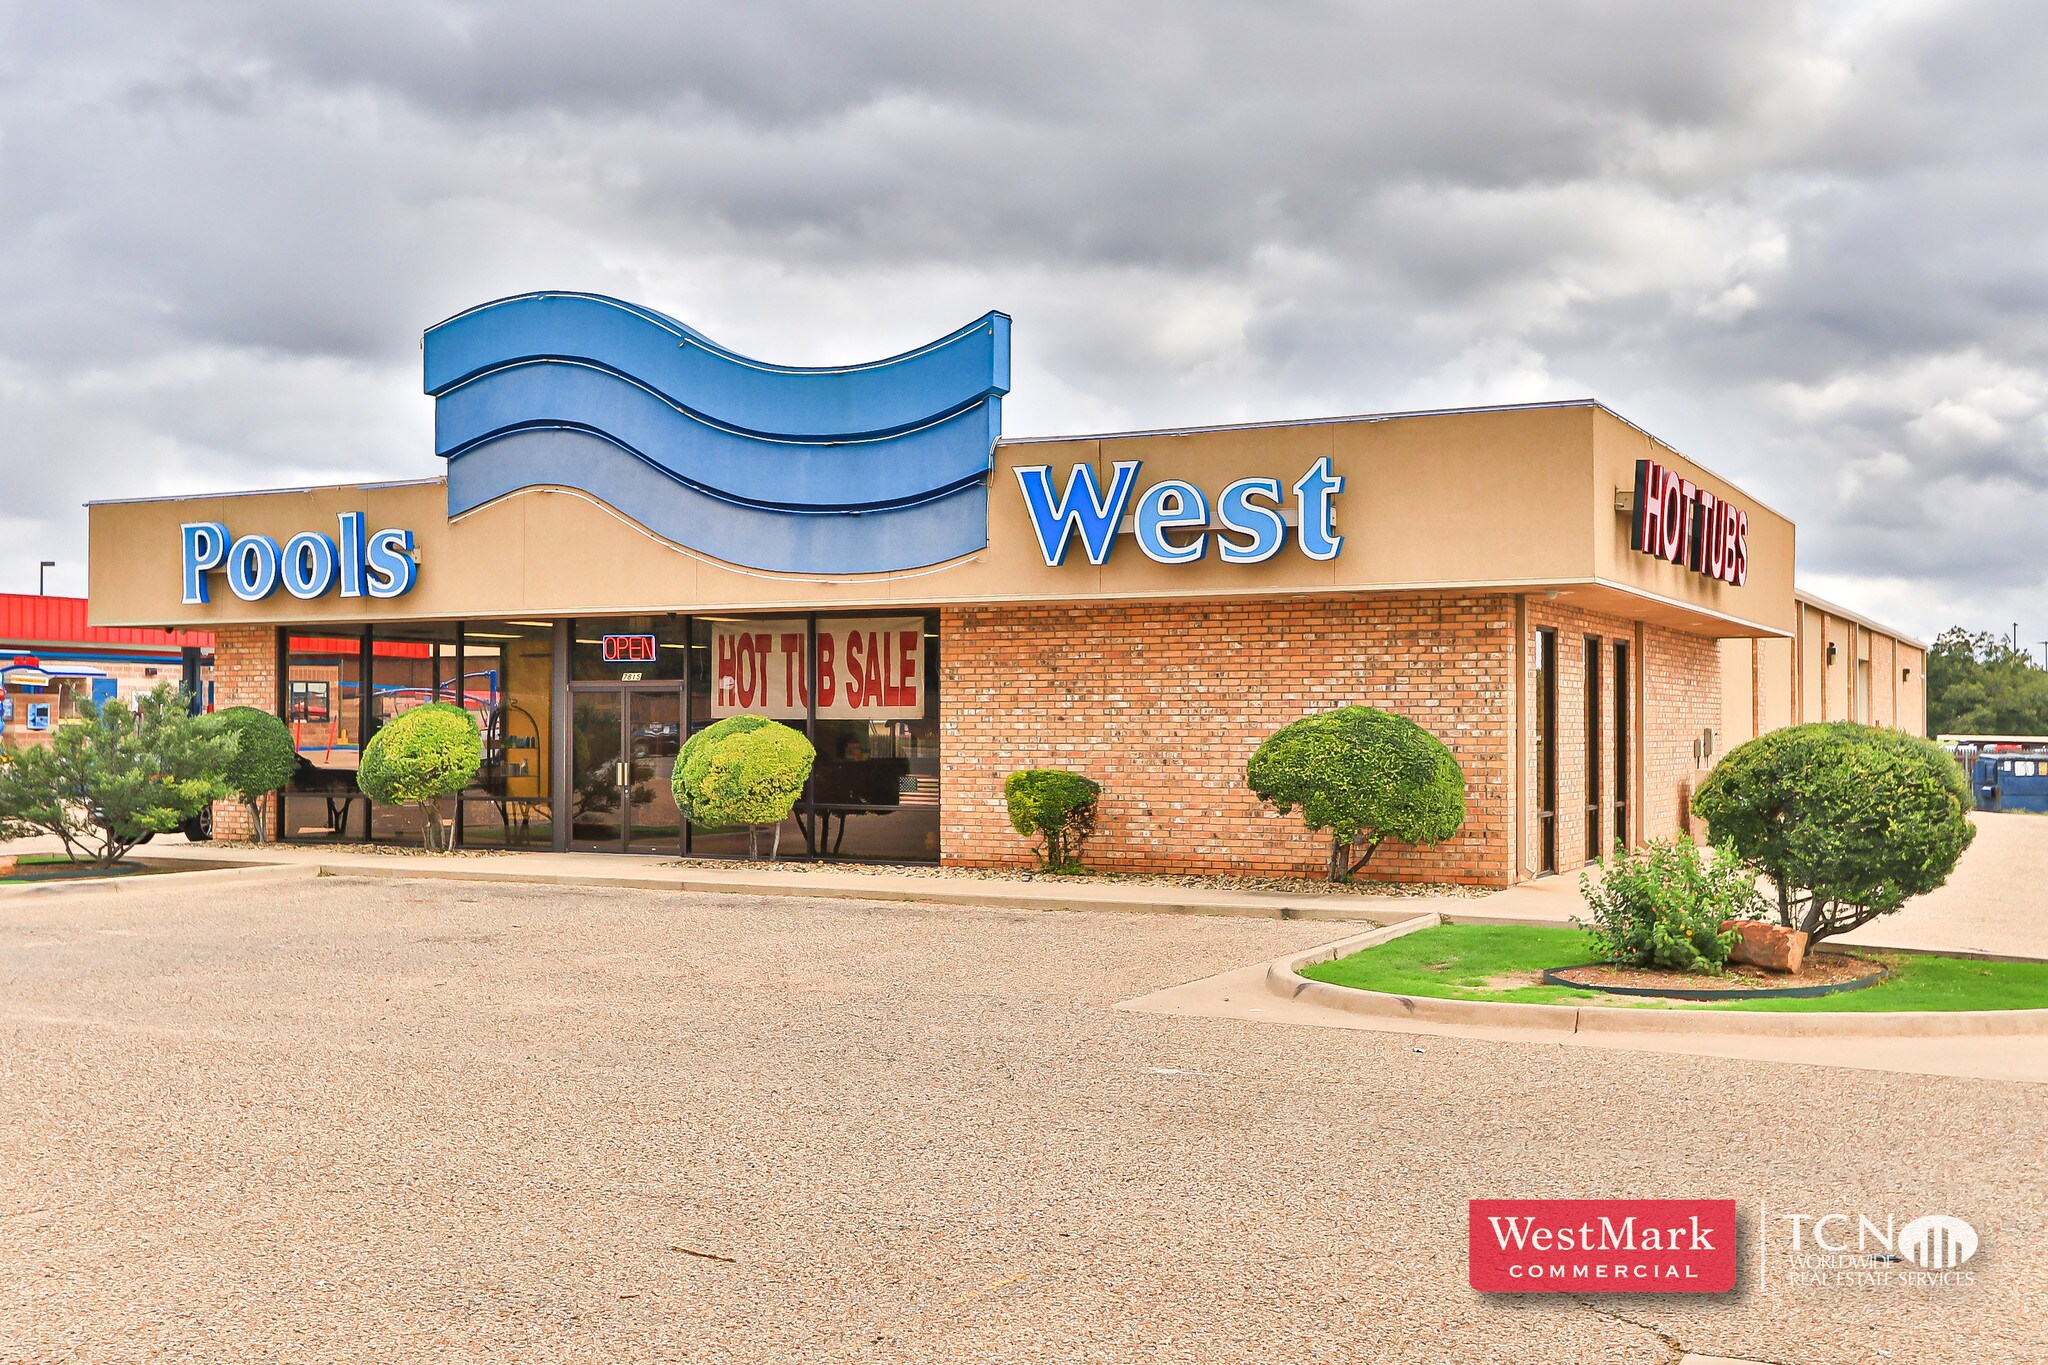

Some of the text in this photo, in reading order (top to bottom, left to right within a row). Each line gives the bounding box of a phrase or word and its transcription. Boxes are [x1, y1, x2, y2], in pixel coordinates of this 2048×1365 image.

[180, 511, 417, 605] Pools
[1011, 456, 1345, 567] West
[1631, 459, 1749, 587] HOT TUBS
[604, 635, 655, 660] OPEN
[718, 632, 772, 709] HOT
[845, 629, 918, 709] SALE
